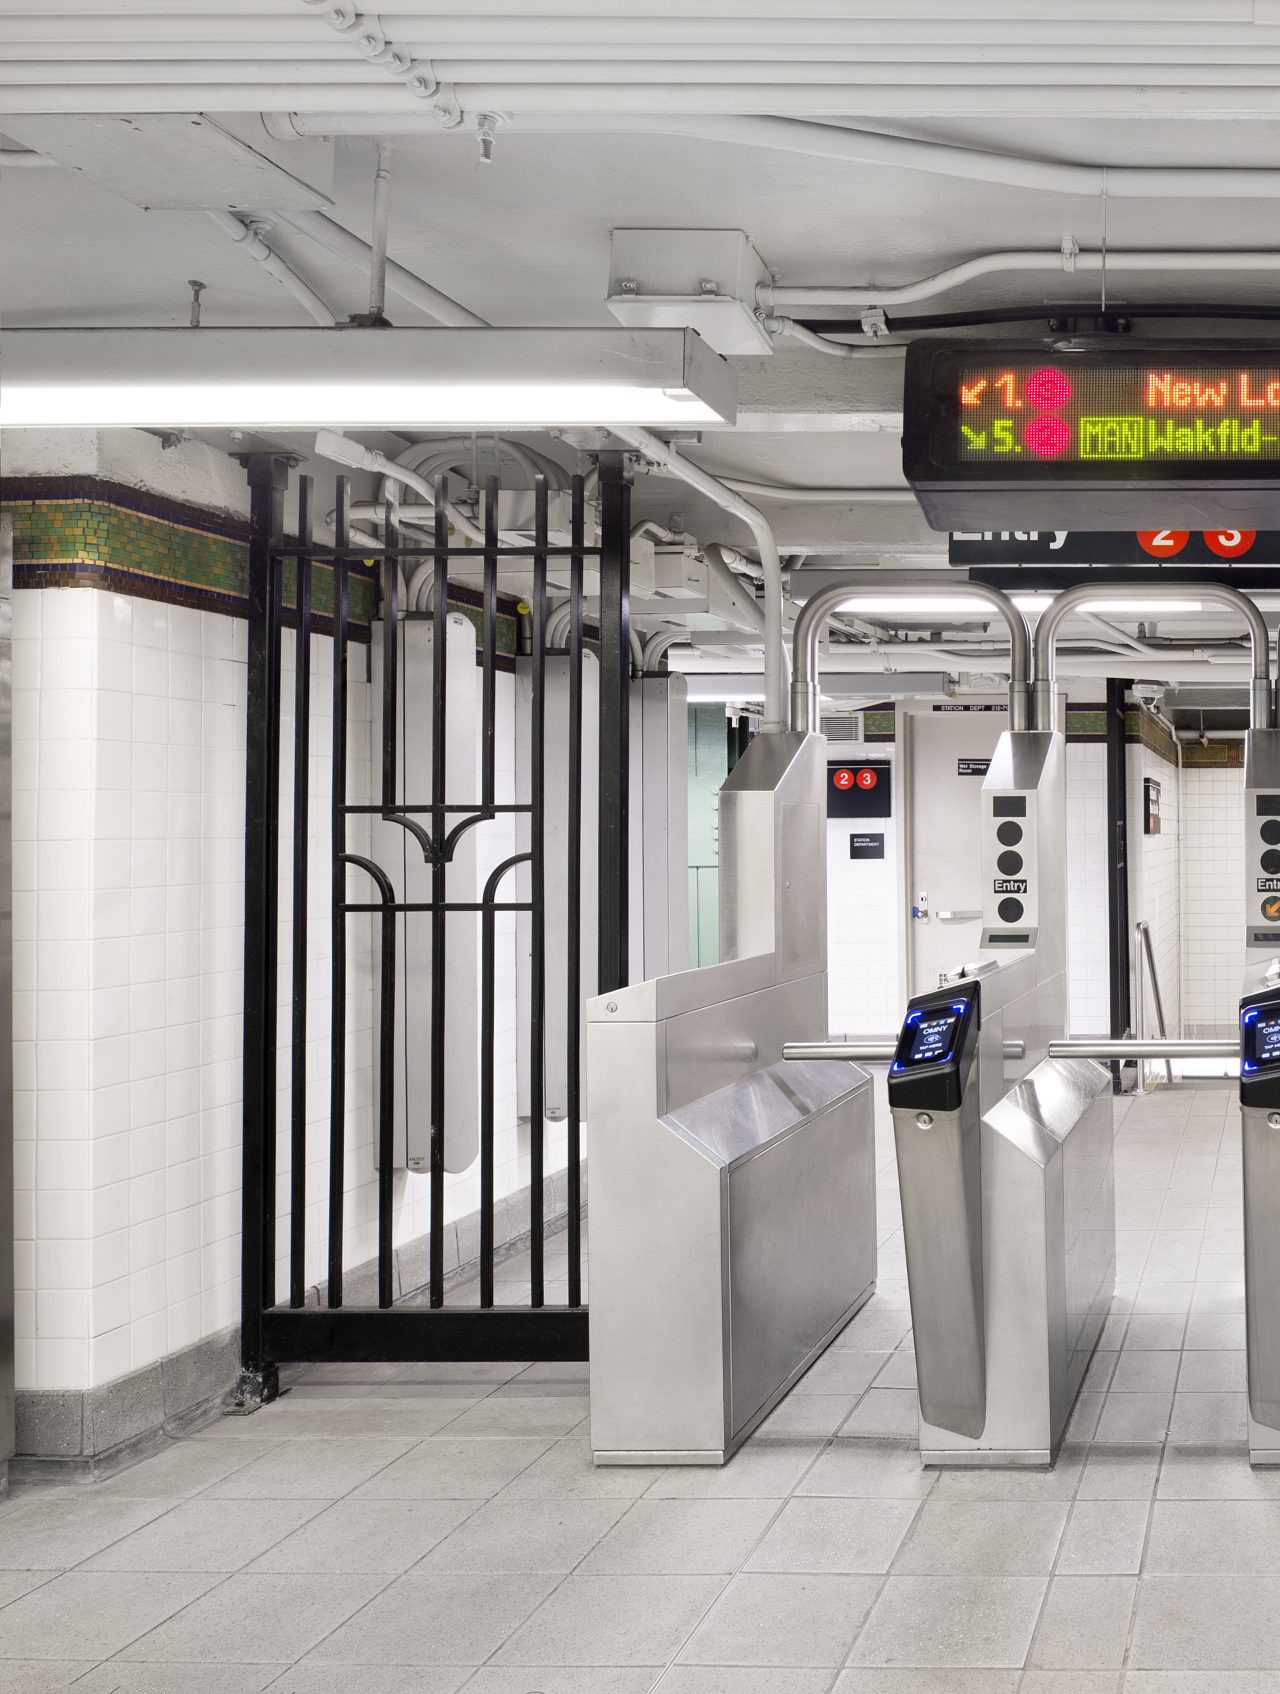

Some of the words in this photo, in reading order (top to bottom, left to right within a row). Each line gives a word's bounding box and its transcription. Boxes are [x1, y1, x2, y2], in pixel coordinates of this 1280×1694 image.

[1147, 373, 1228, 408] New
[1081, 421, 1140, 454] MAN
[840, 772, 849, 785] 2
[862, 772, 871, 785] 3
[995, 880, 1027, 893] Entry
[922, 1025, 949, 1035] OMNY
